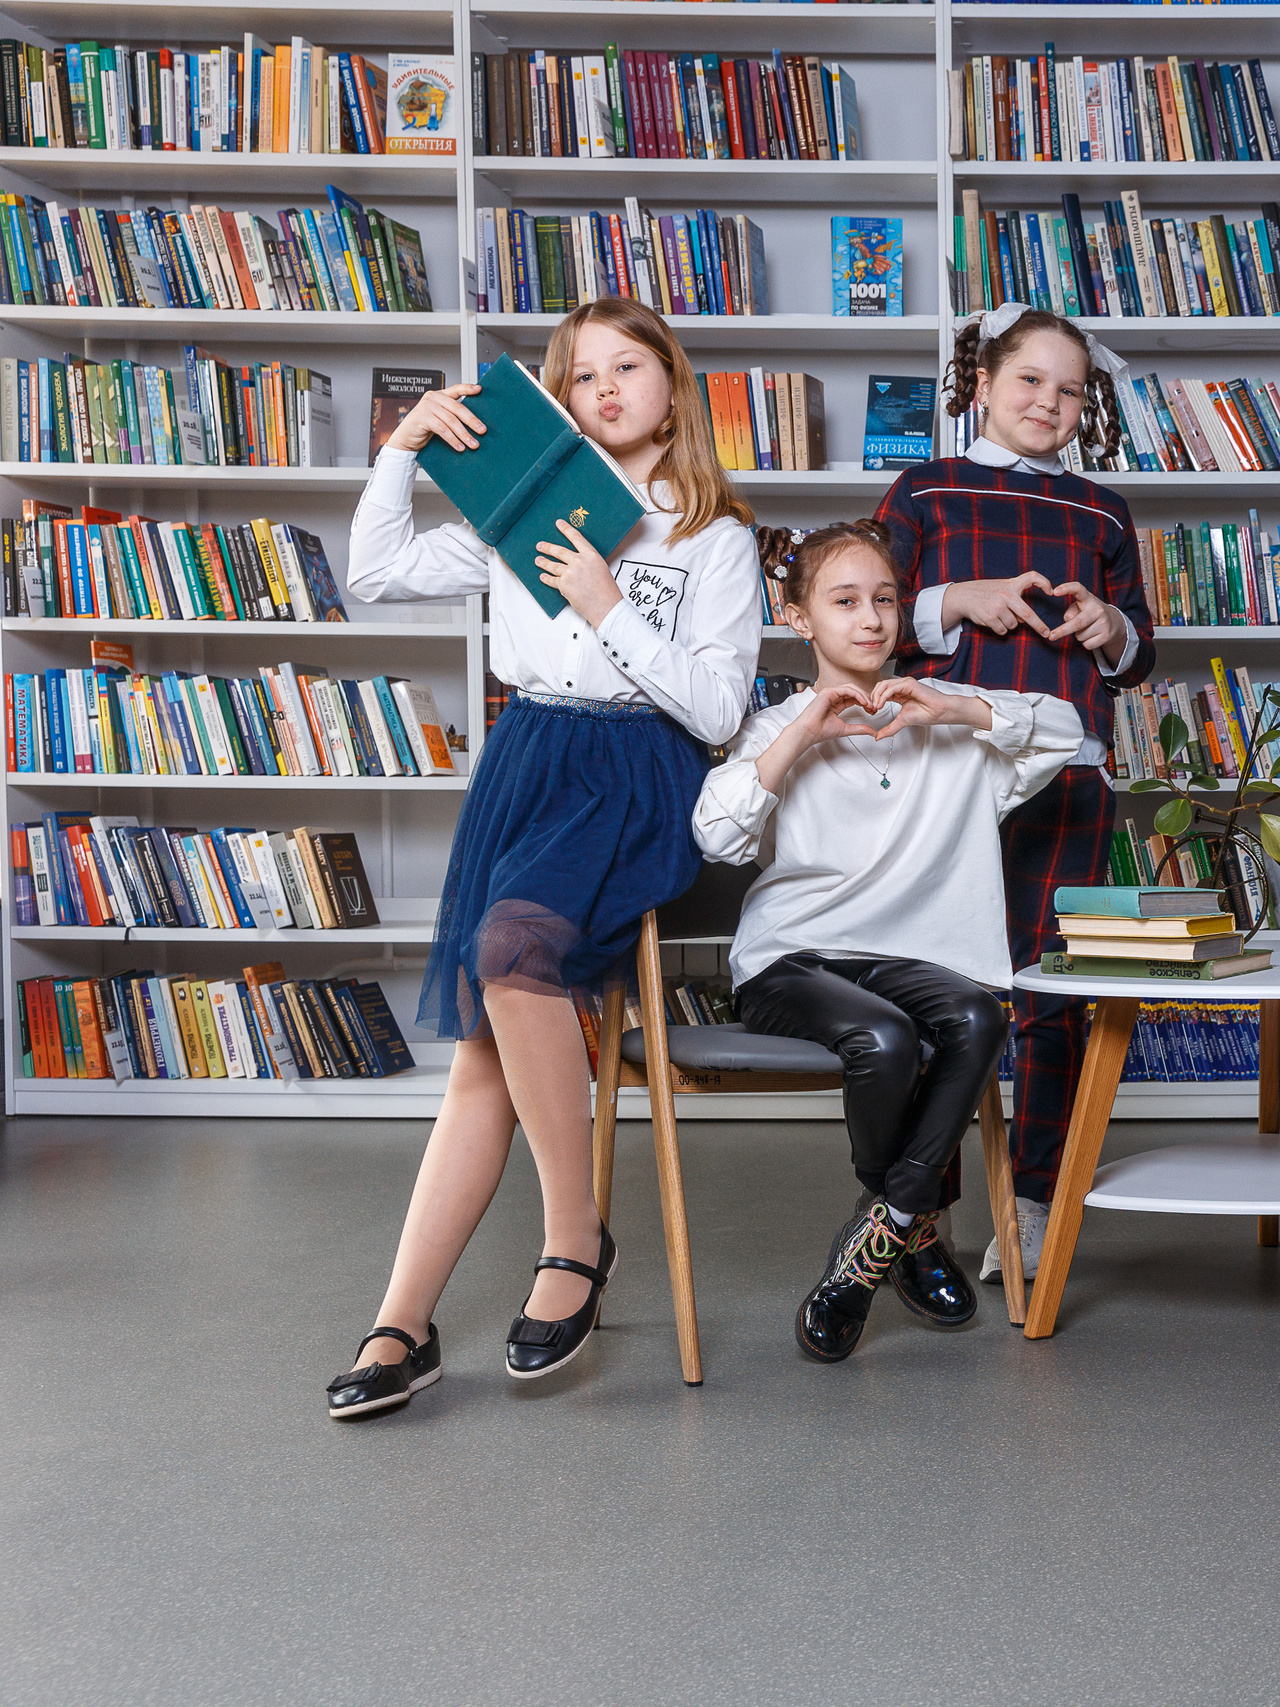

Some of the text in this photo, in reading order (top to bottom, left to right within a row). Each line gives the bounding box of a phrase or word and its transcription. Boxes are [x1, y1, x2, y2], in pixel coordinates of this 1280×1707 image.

[392, 68, 455, 91] УДИВИТЕЛЬНЫЕ
[638, 63, 644, 76] 2
[661, 64, 668, 78] 2
[342, 69, 362, 132] ОБЩАЯ ЭКОЛОГИЯ
[389, 138, 453, 152] ОТКРЫТИЯ
[197, 211, 213, 253] ЭКОЛОГИЯ
[211, 212, 227, 254] ЭКОЛОГИЯ
[641, 213, 651, 241] Ландау
[1129, 205, 1146, 267] ЛАНДШАФТЫ
[162, 218, 189, 304] ПРИРОДОПОЛЬЗОВАНИЕ
[486, 246, 496, 290] МЕХАНИКА
[614, 235, 626, 287] ФИЗИКА
[676, 228, 694, 303] ФИЗИКА
[1033, 241, 1043, 272] ГЕОГРАФИЯ
[334, 257, 349, 289] Экология
[369, 261, 384, 301] ЭКОЛОГИЯ
[850, 284, 886, 298] 1001
[74, 367, 83, 392] ПРИРОДЫ
[382, 373, 432, 385] Инженерная
[388, 384, 425, 393] экология
[733, 377, 739, 386] 2
[4, 383, 13, 431] ЭКОЛОГИЯ
[19, 378, 29, 442] ОБЩАЯ ЭКОЛОГИЯ
[53, 371, 68, 452] ЭКОЛОГИЯ ЧЕЛОВЕКА
[78, 393, 87, 413] ОХРАНА
[778, 387, 787, 420] ФИЗИКИ
[794, 386, 804, 442] КУРС ФИЗИКИ
[1239, 390, 1263, 439] ГЕОГРАФИЕЙ
[81, 419, 90, 444] ЭКОЛОГИЯ
[867, 443, 926, 455] ФИЗИКА
[58, 523, 66, 553] РЕПЕТИТОР
[177, 530, 188, 558] МАТЕМАТИКЕ
[17, 550, 26, 610] СПРАВОЧНИК СТАЛКЕРА
[72, 526, 87, 613] РЕПЕТИТОР ПО МАТЕМАТИКЕ
[198, 540, 223, 612] МАТЕМАТИКА
[629, 590, 654, 606] are
[50, 677, 60, 734] ВЫСШАЯ МАТЕМАТИКА
[86, 675, 96, 710] МАТЕМАТИКА
[16, 689, 27, 766] МАТЕМАТИКА
[1147, 706, 1157, 734] БОЛГАРИЯ
[1214, 710, 1224, 735] ВЕНГРИЯ
[1244, 855, 1258, 897] ФРАНЦИЯ
[54, 982, 64, 992] 10
[64, 982, 73, 992] 10
[1149, 968, 1201, 980] Сельское
[105, 1006, 117, 1027] алгебра
[241, 996, 253, 1024] ГЕОМЕТРИЯ
[147, 1018, 166, 1068] ГЕОМЕТРИЯ
[217, 1005, 237, 1062] ТРИГОНОМЕТРИЯ
